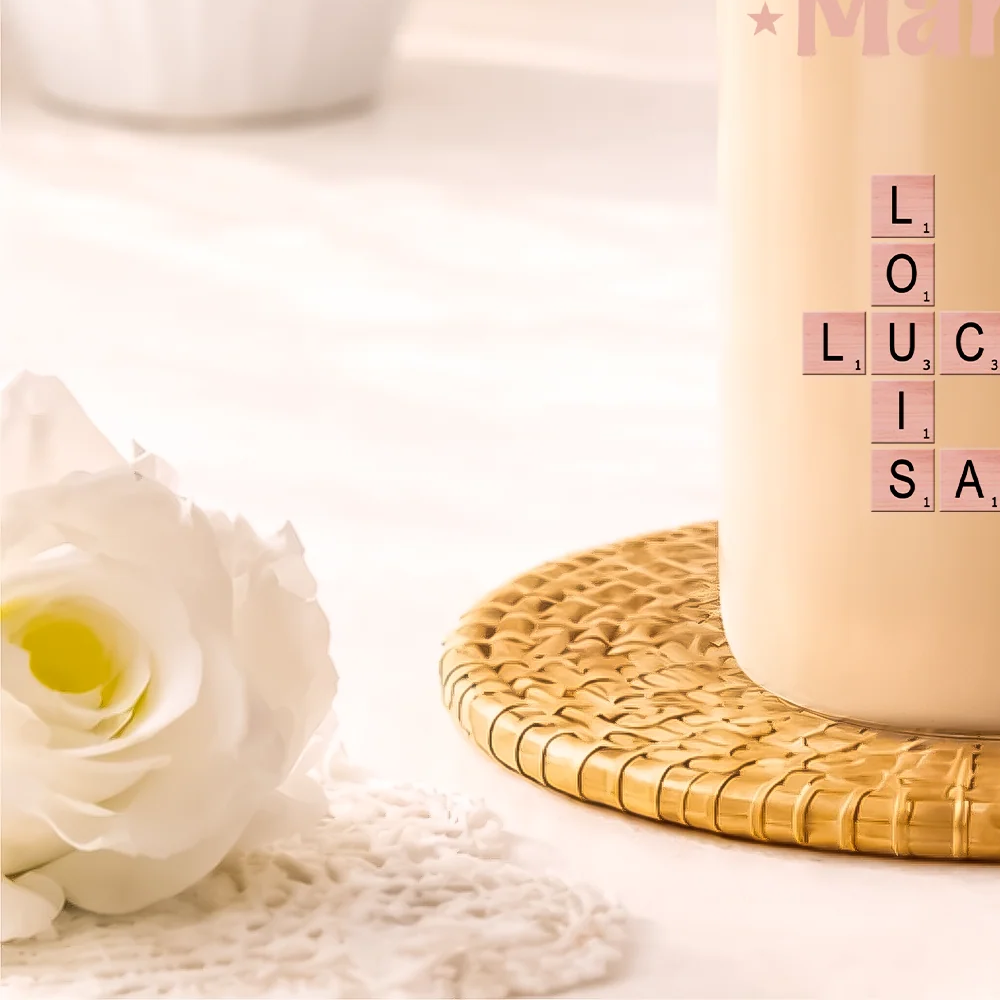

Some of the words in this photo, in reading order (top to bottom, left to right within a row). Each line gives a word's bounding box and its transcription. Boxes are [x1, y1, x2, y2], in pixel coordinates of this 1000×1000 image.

[923, 223, 930, 233] 1
[923, 291, 930, 301] 1
[886, 184, 918, 499] LOUIS
[855, 360, 861, 370] 1
[923, 360, 930, 370] 3
[991, 360, 998, 370] 3
[923, 428, 930, 438] 1
[924, 497, 930, 507] 1
[992, 497, 998, 507] 1
